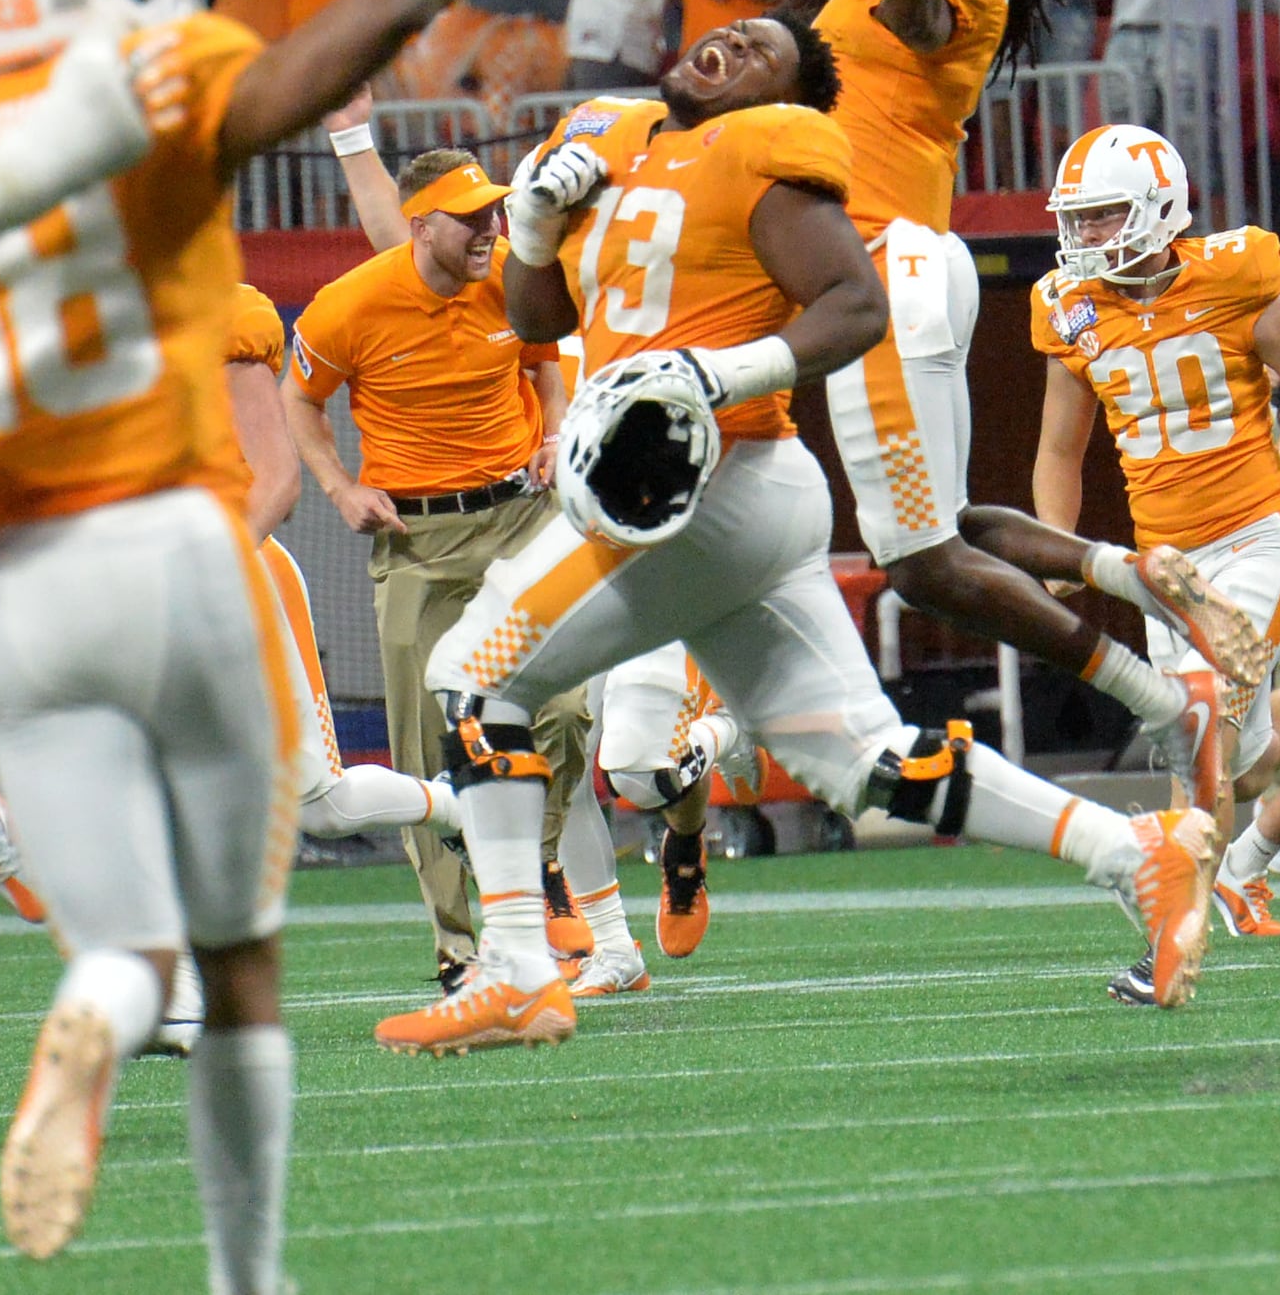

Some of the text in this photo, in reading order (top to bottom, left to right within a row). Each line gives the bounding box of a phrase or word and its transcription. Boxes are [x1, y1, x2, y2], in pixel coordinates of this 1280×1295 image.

[629, 154, 648, 173] T
[1126, 140, 1171, 188] T
[463, 167, 481, 184] T
[898, 255, 928, 278] T
[1137, 312, 1156, 332] T
[1089, 331, 1237, 460] 30
